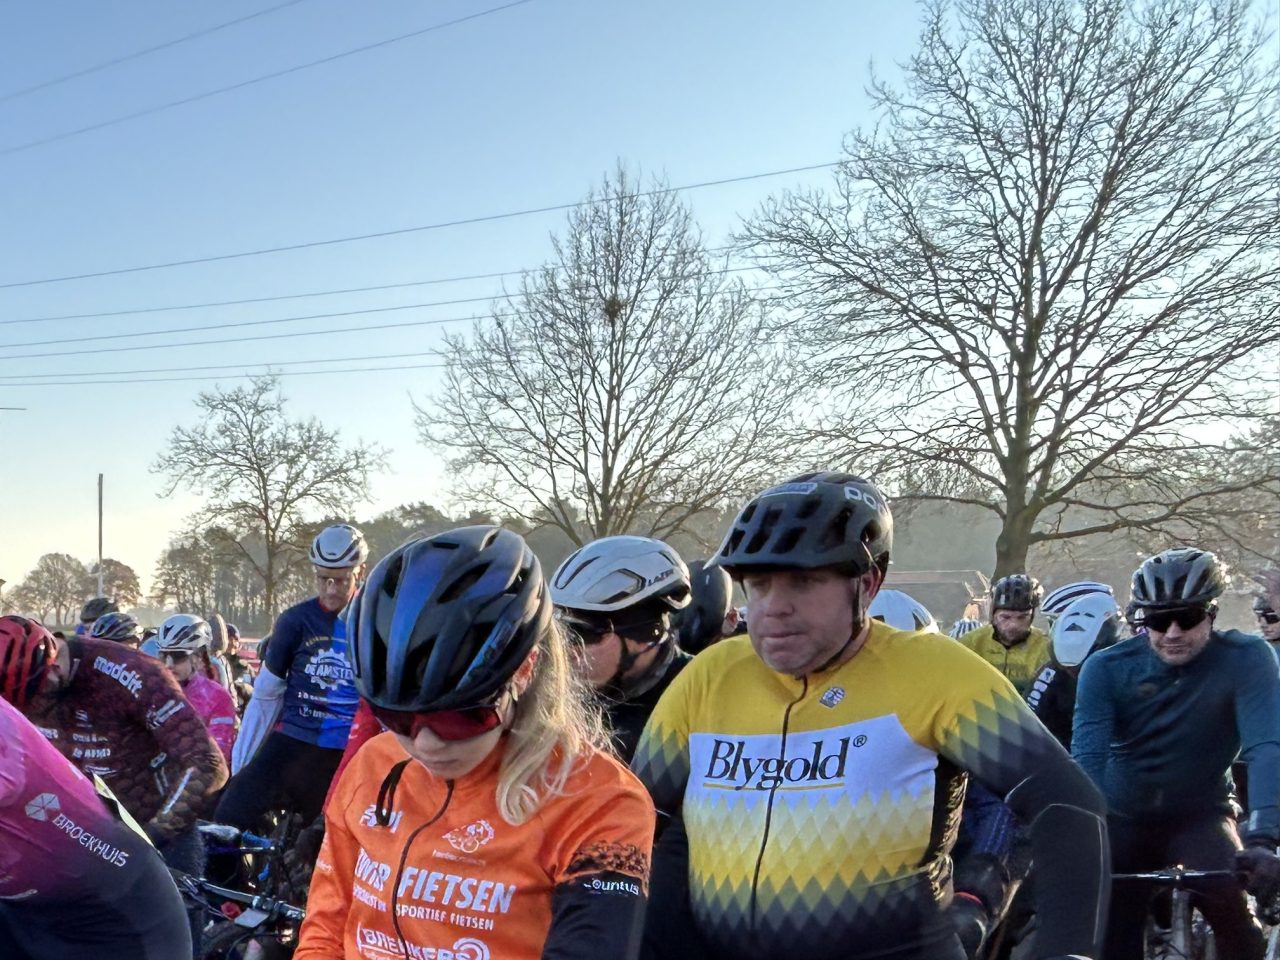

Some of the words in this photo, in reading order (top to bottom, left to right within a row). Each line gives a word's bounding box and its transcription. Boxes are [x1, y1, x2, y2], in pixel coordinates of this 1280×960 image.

[52, 813, 129, 867] BROEKHUIS
[396, 866, 517, 914] FIETSEN
[395, 903, 446, 923] SPORTIEF
[450, 912, 494, 931] FIETSEN
